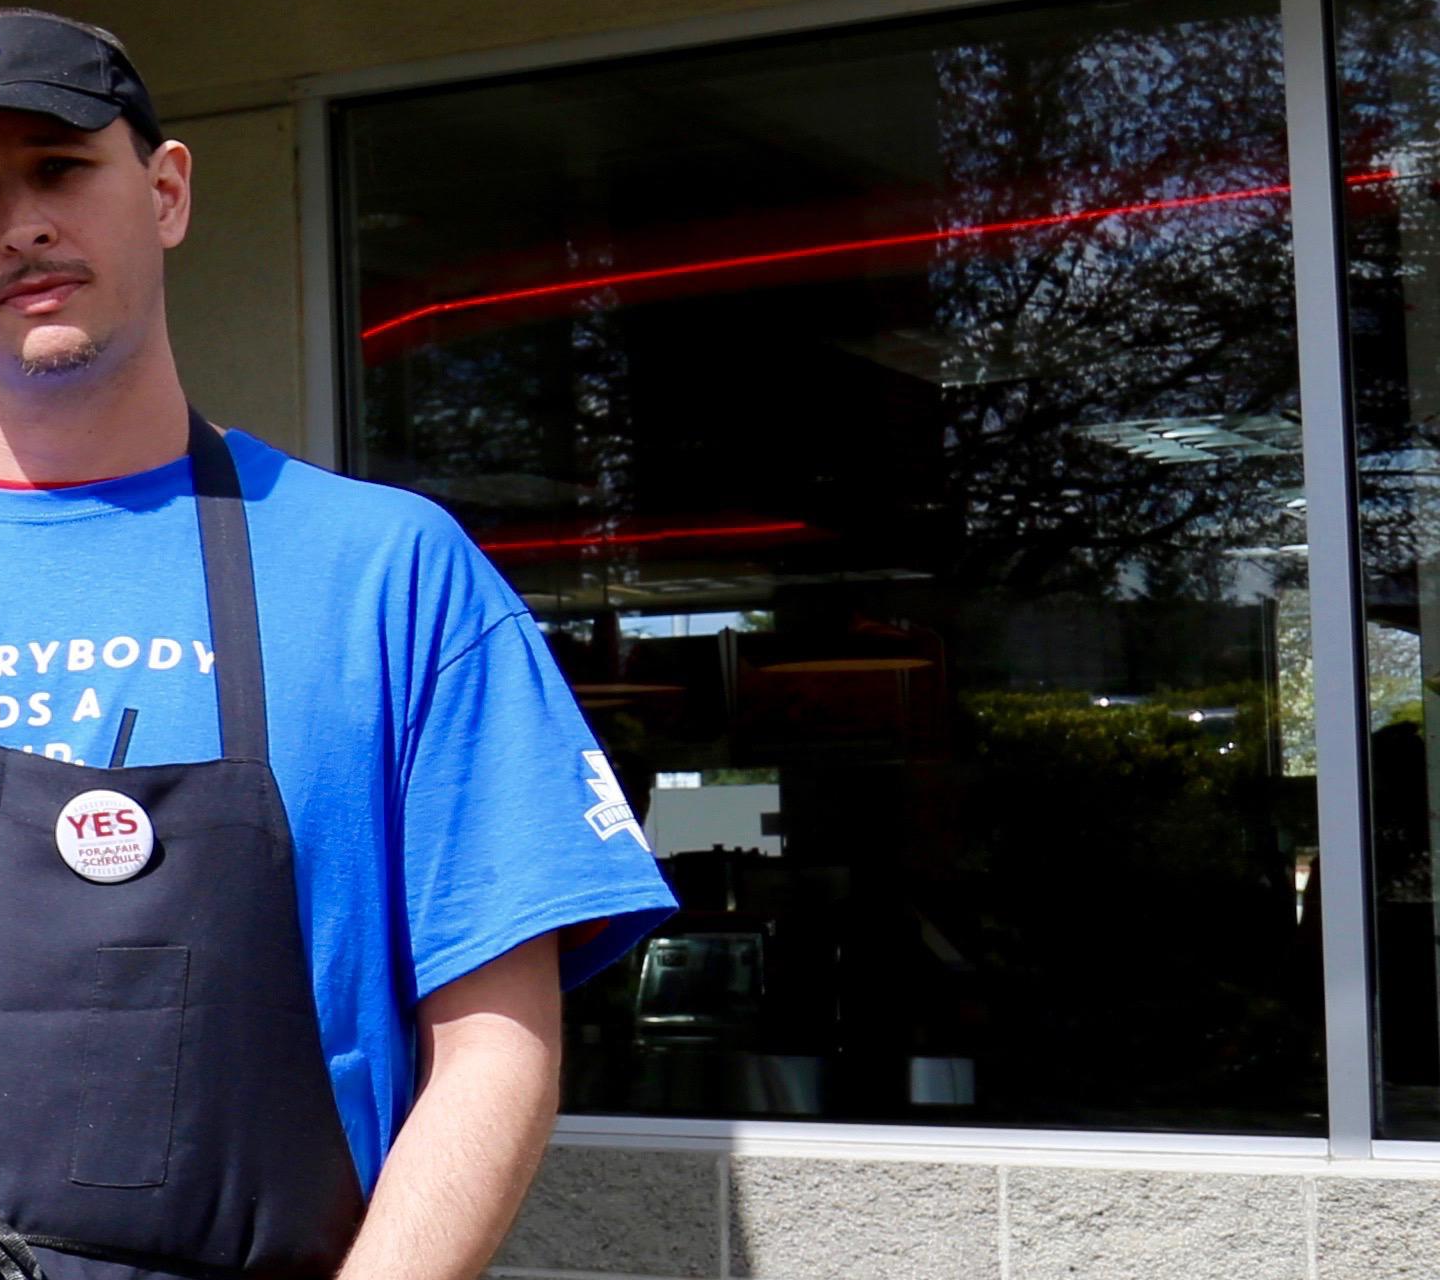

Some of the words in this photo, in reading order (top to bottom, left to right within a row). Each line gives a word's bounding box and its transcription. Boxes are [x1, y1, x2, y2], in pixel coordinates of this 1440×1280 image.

[72, 687, 102, 722] A
[66, 808, 138, 839] YES
[79, 847, 101, 857] FOR
[103, 847, 113, 855] A
[116, 843, 141, 854] FAIR
[82, 853, 142, 868] SCHEDULE
